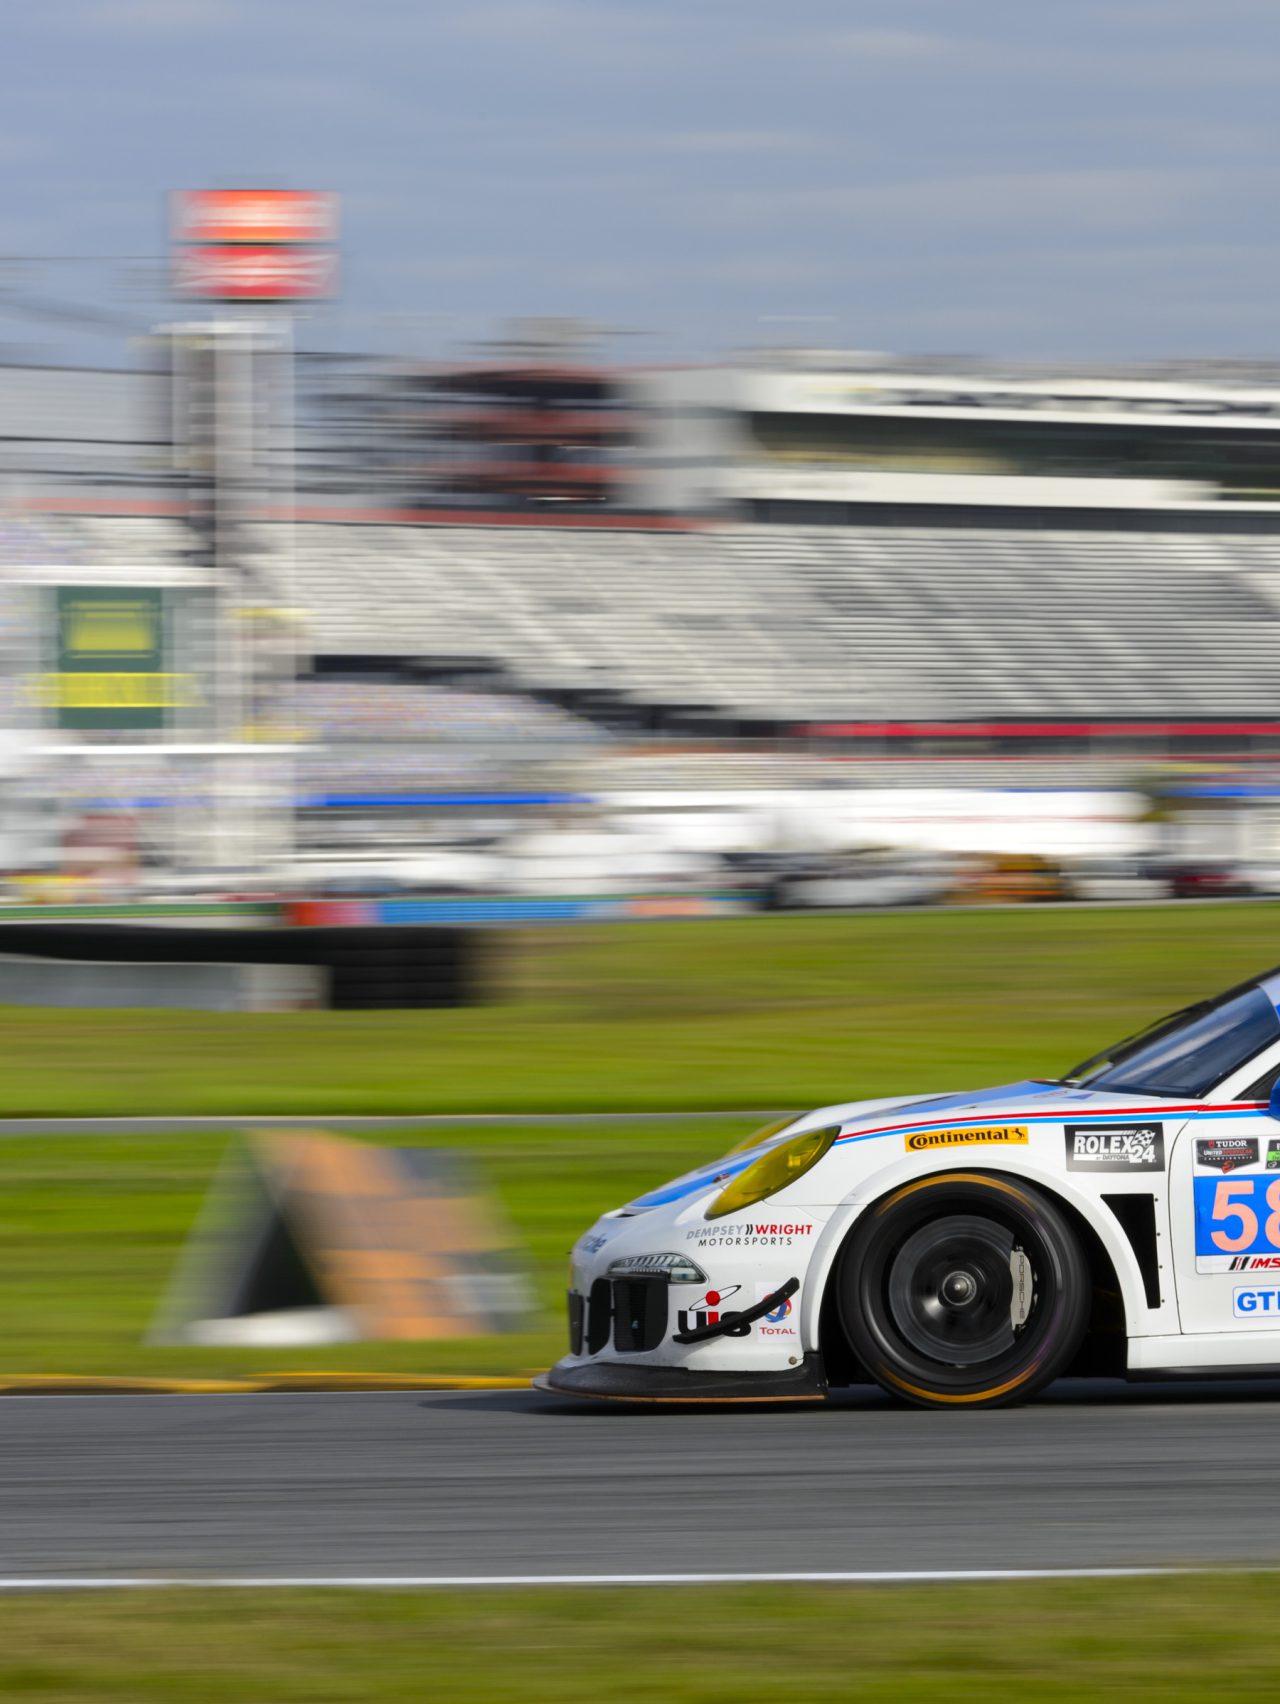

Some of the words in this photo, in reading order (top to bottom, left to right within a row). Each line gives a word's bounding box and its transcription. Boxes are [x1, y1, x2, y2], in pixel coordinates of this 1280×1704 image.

[909, 1128, 1009, 1150] Continental
[1073, 1136, 1135, 1154] ROLEX
[1216, 1140, 1248, 1148] TUDOR
[1129, 1144, 1156, 1163] 24
[686, 1224, 745, 1240] DEMPSEY
[755, 1224, 814, 1236] WRIGHT
[698, 1236, 793, 1248] MOTORSPORTS
